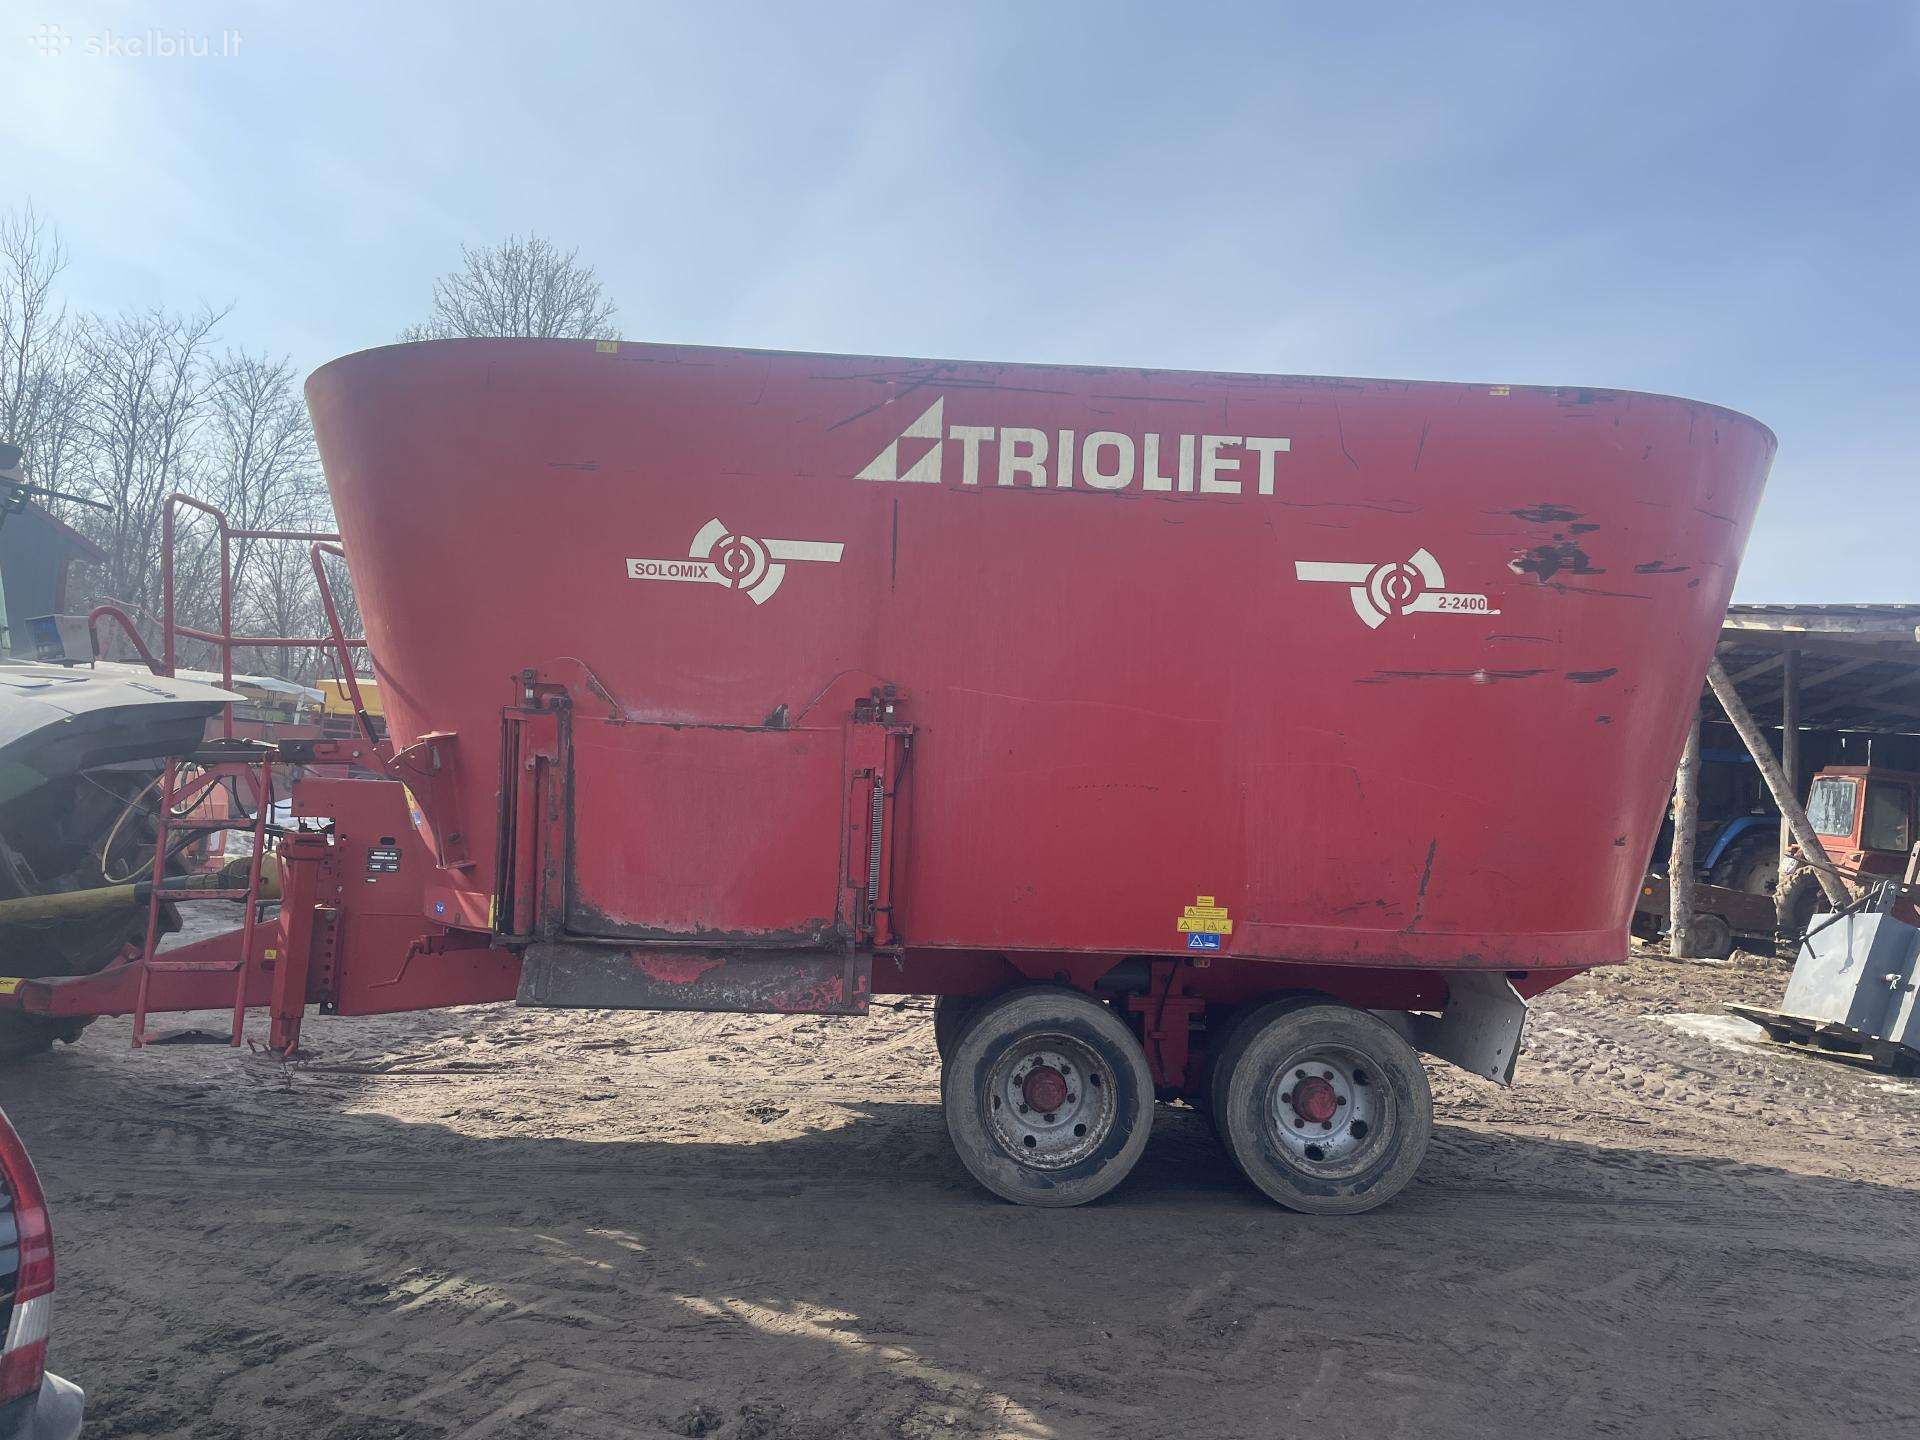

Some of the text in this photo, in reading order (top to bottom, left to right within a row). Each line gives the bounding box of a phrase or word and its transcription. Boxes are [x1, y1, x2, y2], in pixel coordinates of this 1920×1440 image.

[949, 425, 1291, 495] TRIOLIET
[634, 562, 708, 578] SOLOMIX
[1438, 596, 1486, 611] 2-2400
